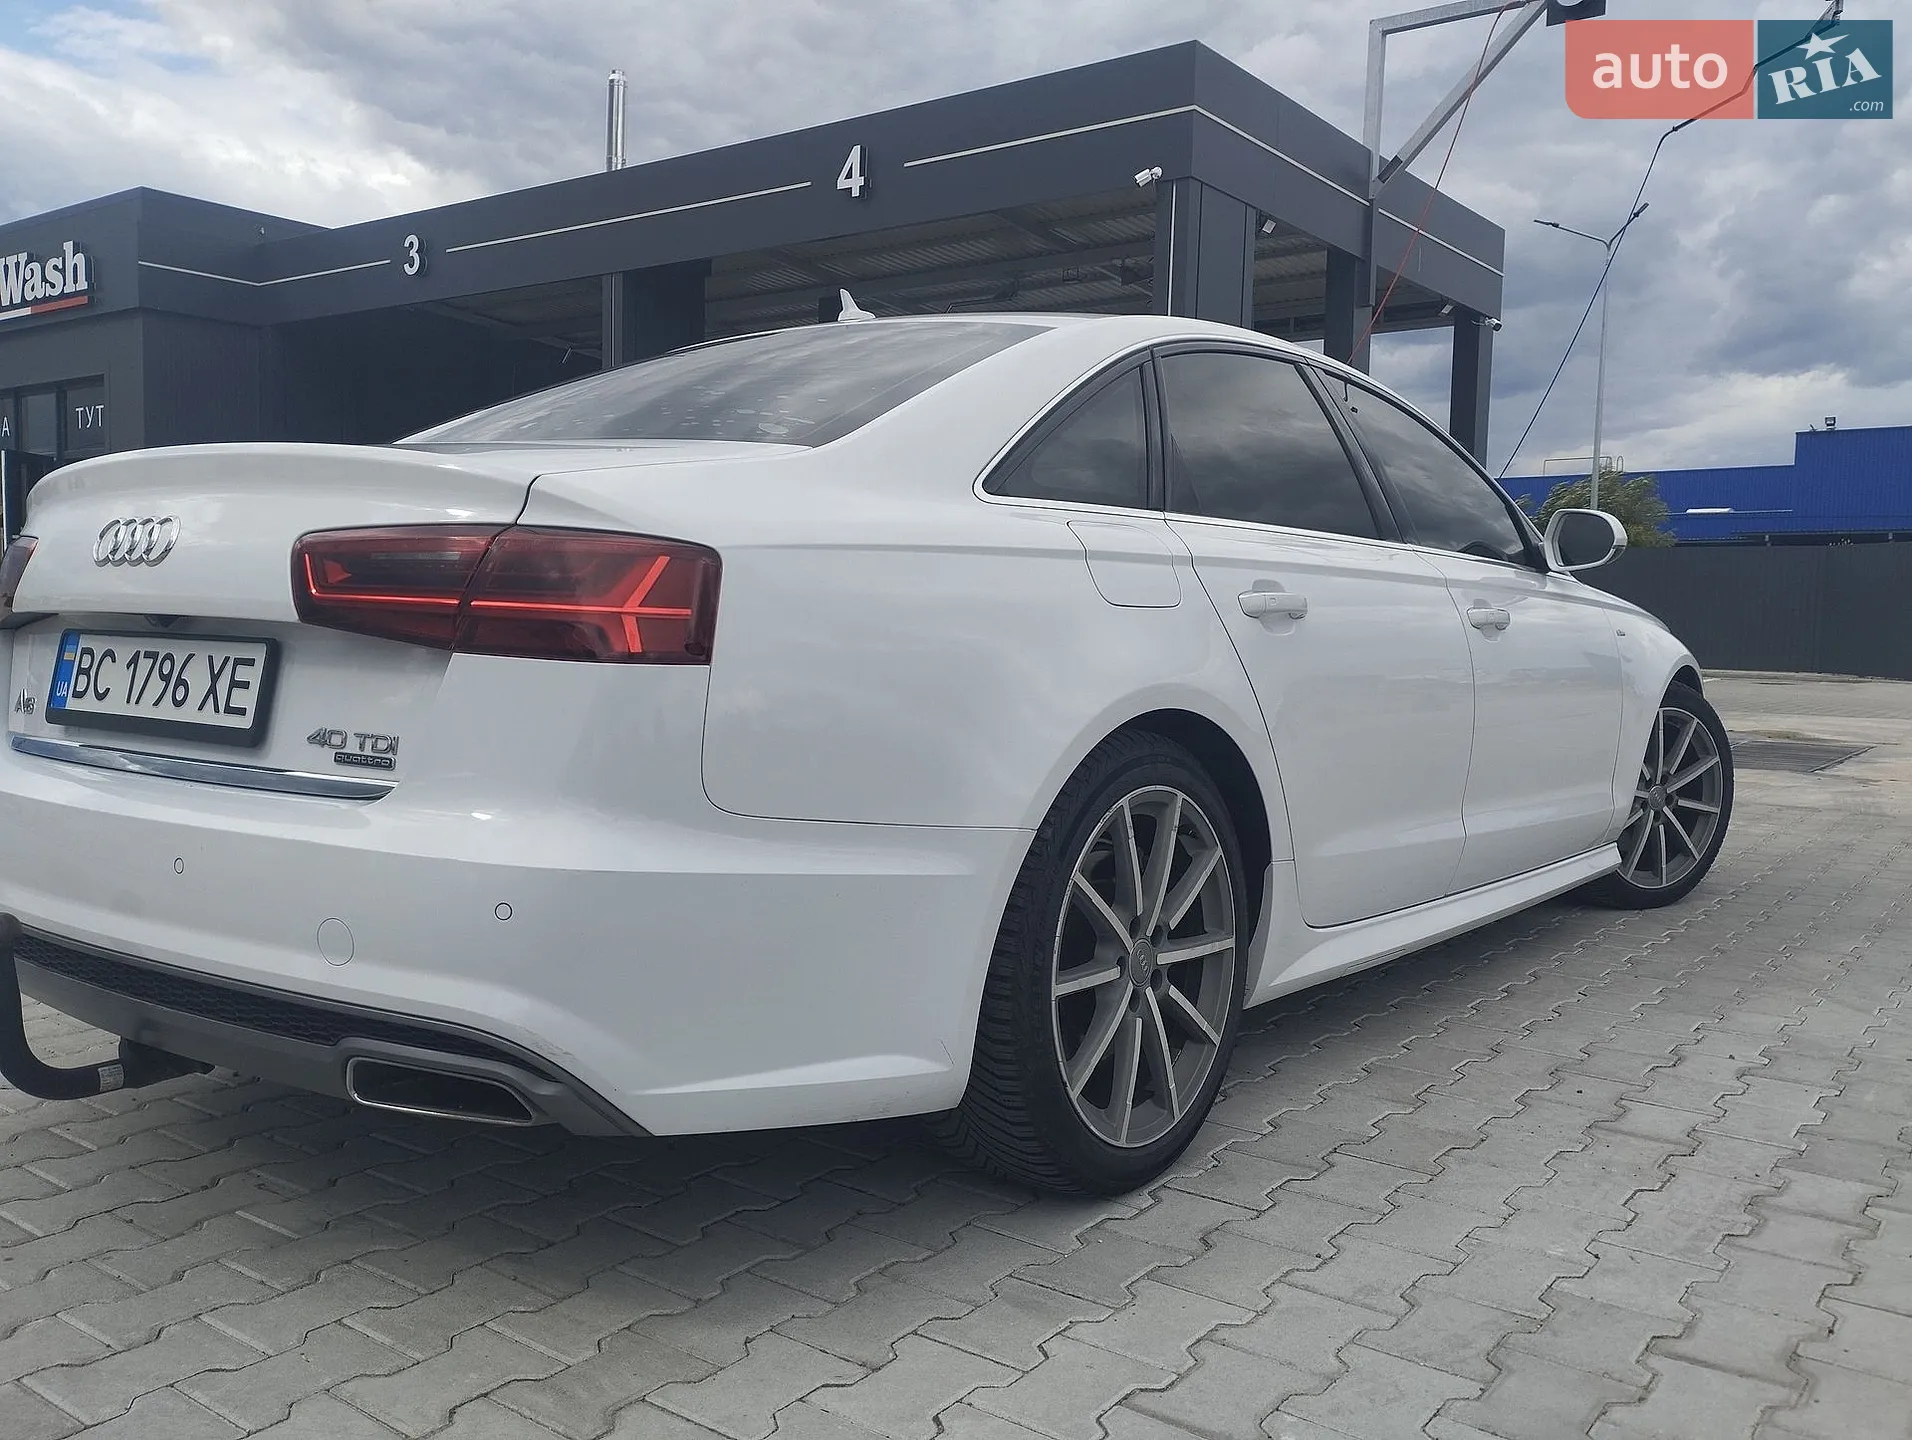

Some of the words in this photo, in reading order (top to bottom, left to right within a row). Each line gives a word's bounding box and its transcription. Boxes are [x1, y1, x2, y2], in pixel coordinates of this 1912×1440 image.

[836, 145, 865, 197] 4
[403, 234, 421, 276] 3
[0, 240, 88, 306] Wash
[75, 405, 105, 428] ТУТ
[56, 680, 68, 697] UA
[72, 646, 116, 701] BC
[125, 650, 196, 708] 1796
[198, 655, 256, 716] XE
[14, 688, 36, 714] A6
[306, 728, 348, 749] 40
[354, 732, 399, 755] TDI
[335, 754, 391, 767] quattro
